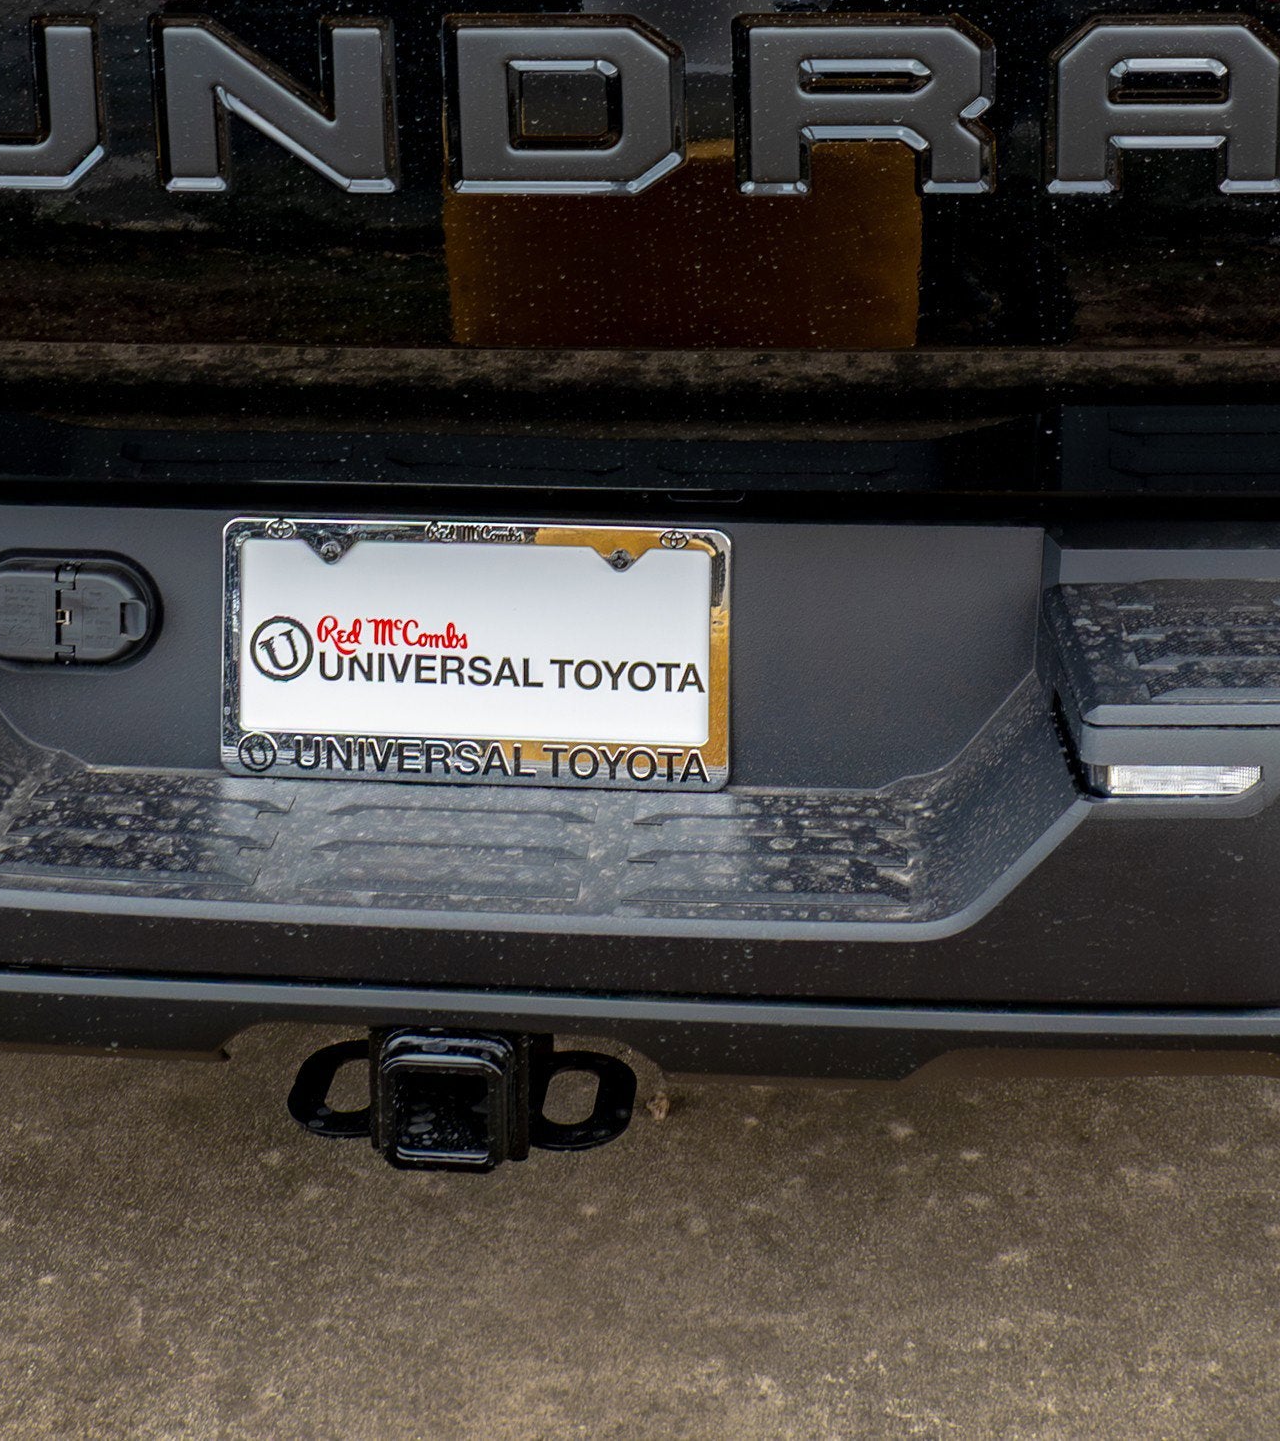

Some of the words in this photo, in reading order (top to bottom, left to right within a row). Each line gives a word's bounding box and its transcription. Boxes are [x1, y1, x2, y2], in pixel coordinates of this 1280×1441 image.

[317, 615, 361, 655] Red
[367, 617, 468, 650] McCombs
[319, 652, 543, 689] UNIVERSAL
[549, 659, 705, 694] TOYOTA
[294, 735, 537, 777] UNIVERSAL
[542, 743, 710, 783] TOYOTA
